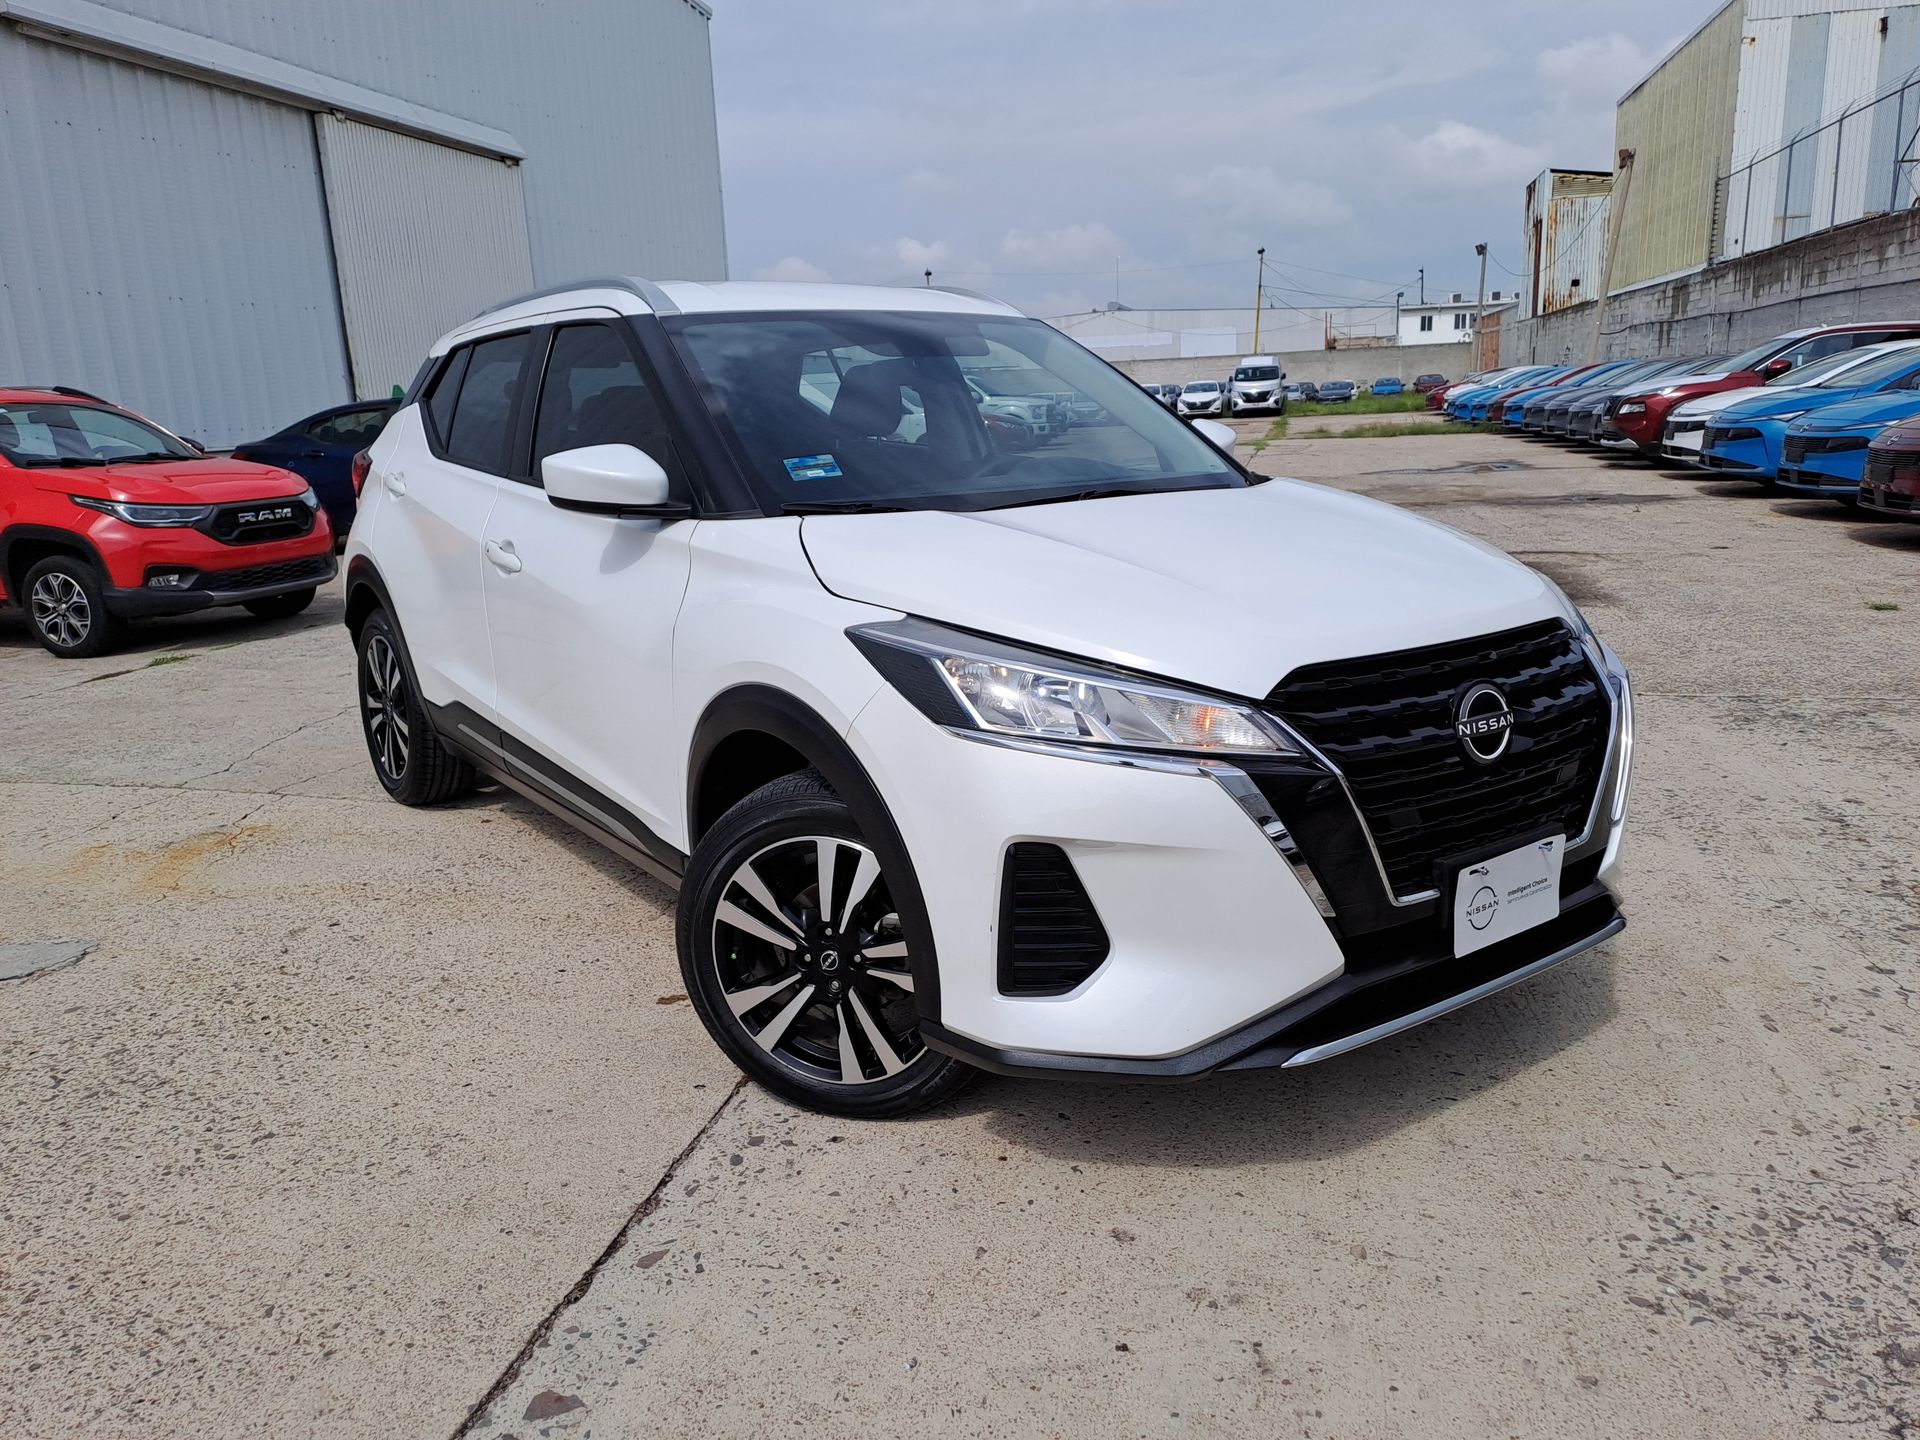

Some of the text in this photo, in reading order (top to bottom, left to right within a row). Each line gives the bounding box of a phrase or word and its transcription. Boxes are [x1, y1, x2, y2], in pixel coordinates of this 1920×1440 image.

[238, 507, 292, 523] RAM
[1458, 712, 1514, 736] NISSAN
[1466, 899, 1500, 918] NISSAN
